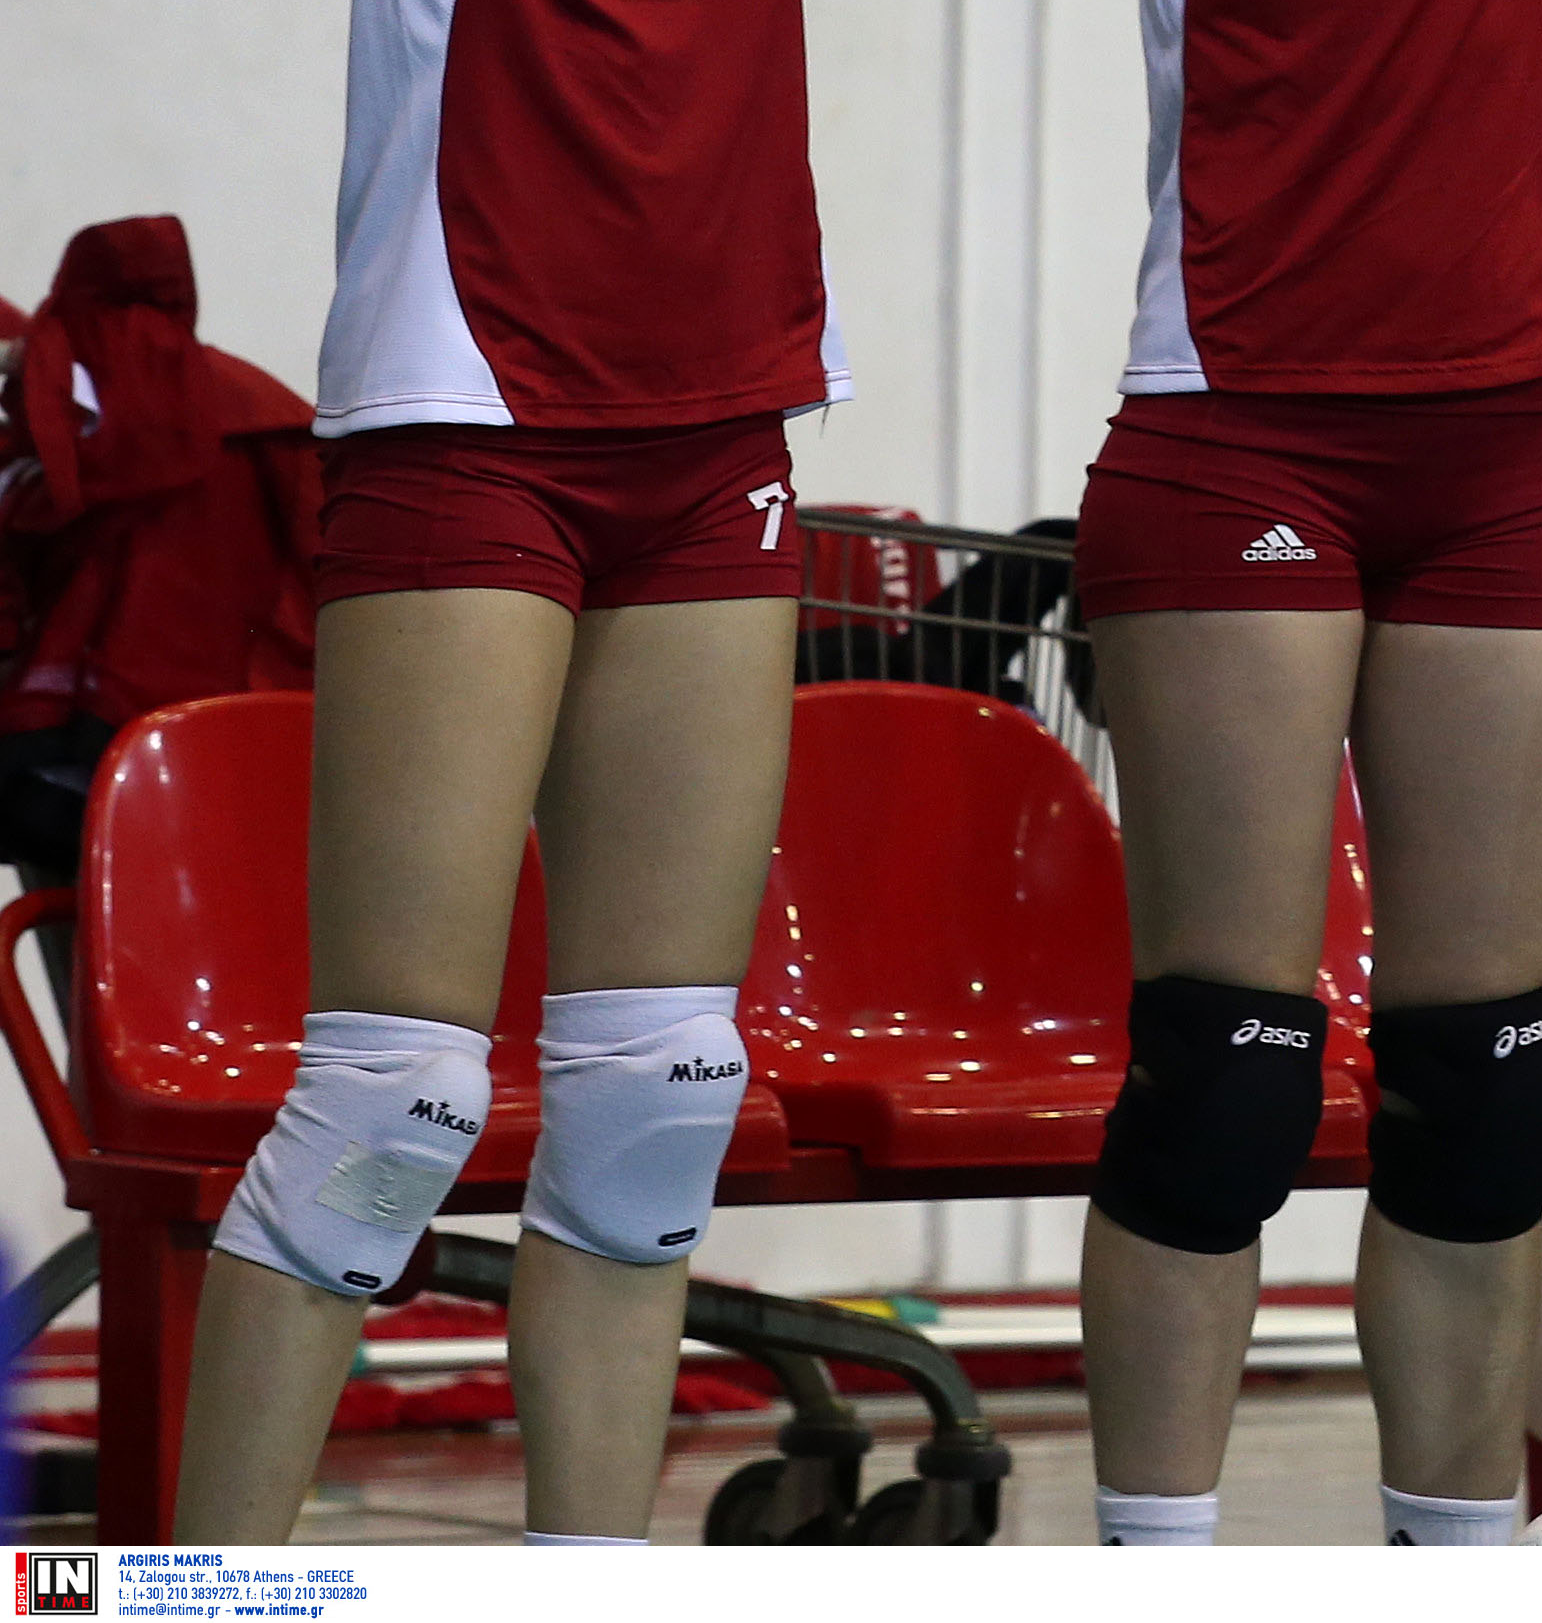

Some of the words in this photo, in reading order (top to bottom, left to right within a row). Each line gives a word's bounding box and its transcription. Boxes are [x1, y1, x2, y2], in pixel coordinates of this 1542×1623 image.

[747, 481, 789, 550] 7
[1241, 546, 1317, 562] adidas
[1259, 1024, 1311, 1049] asics
